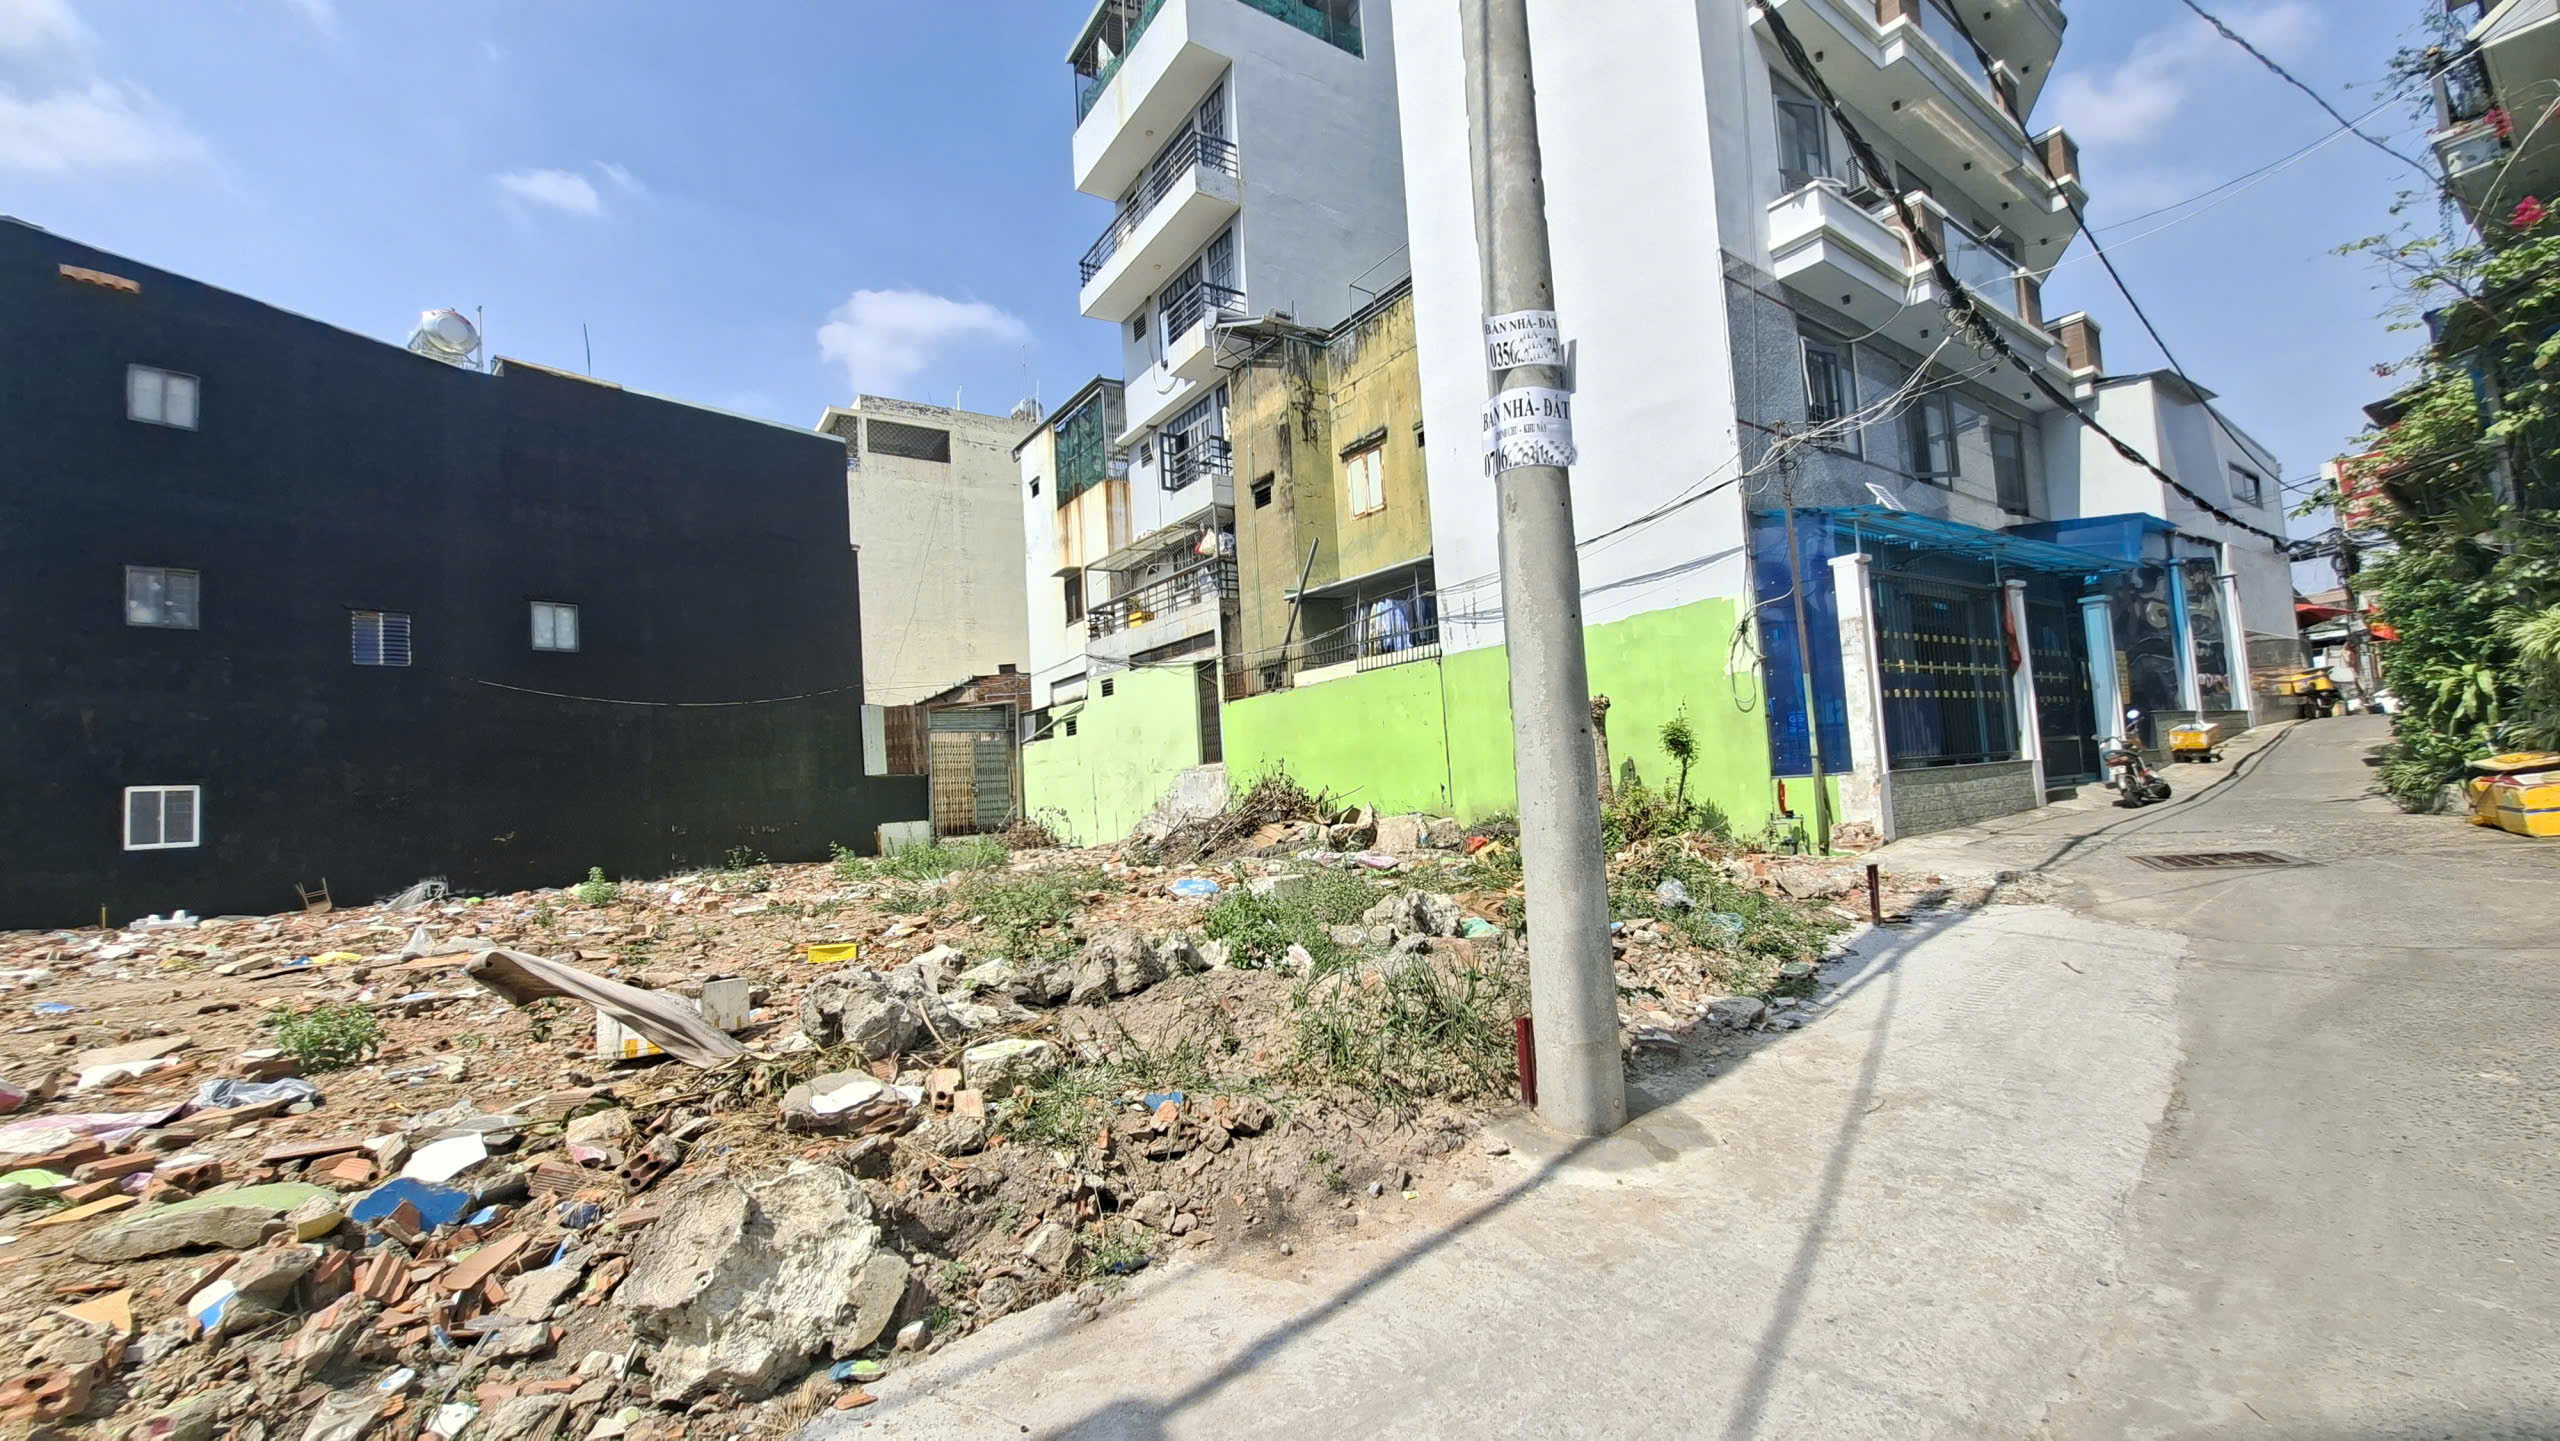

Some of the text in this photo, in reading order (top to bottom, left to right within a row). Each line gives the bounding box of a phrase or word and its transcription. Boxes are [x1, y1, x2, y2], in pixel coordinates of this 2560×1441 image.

[1485, 320, 1507, 335] BÁN
[1483, 402, 1500, 432] BÁN
[1543, 394, 1569, 420] ĐẤT
